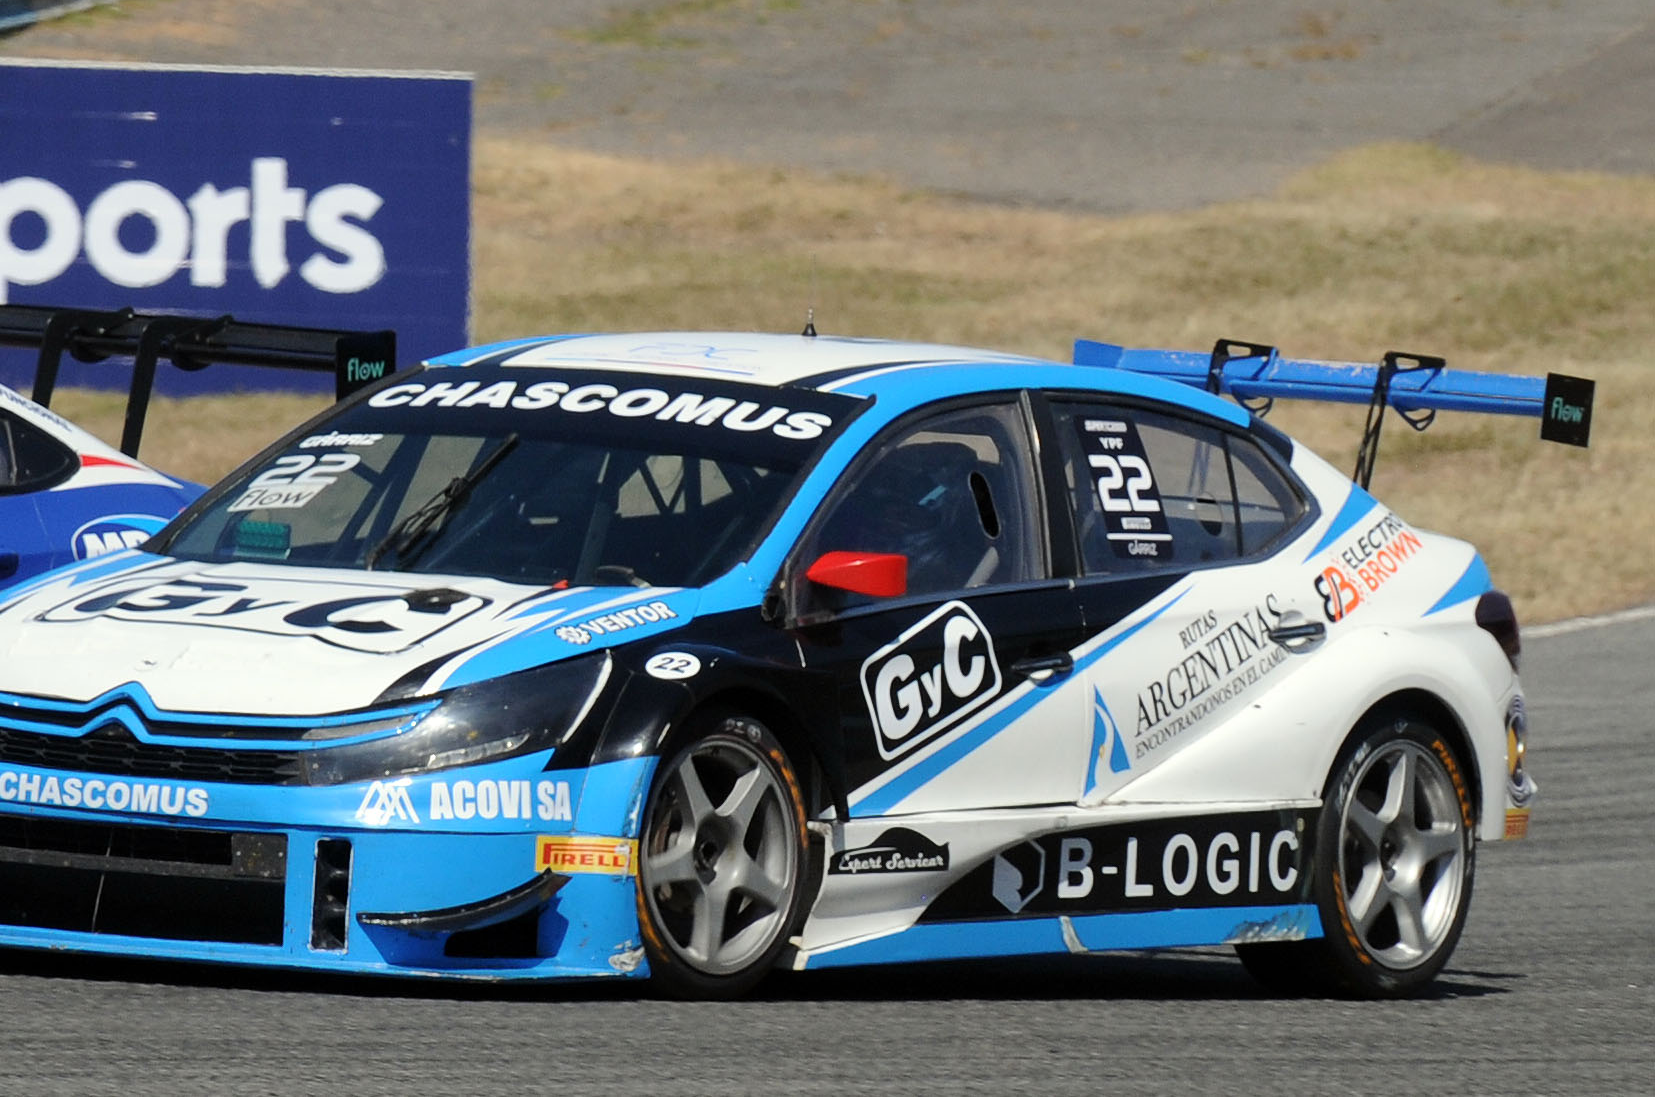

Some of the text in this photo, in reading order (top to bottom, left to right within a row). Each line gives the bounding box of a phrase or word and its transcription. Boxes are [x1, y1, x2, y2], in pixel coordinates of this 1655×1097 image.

[348, 358, 384, 381] flow
[368, 381, 832, 439] CHASCOMUS
[1551, 397, 1585, 423] flow
[1099, 437, 1124, 449] YPF
[248, 454, 360, 489] 22
[1088, 455, 1160, 512] 22
[235, 489, 316, 508] flow
[1358, 530, 1423, 592] BROWN
[580, 601, 678, 635] VENTOR
[1178, 609, 1218, 650] RUTAS
[654, 657, 691, 674] 22
[875, 615, 985, 740] GyC
[430, 780, 573, 821] ACOVI SA
[543, 843, 631, 868] PIRELL
[1058, 830, 1299, 898] B-LOGIC
